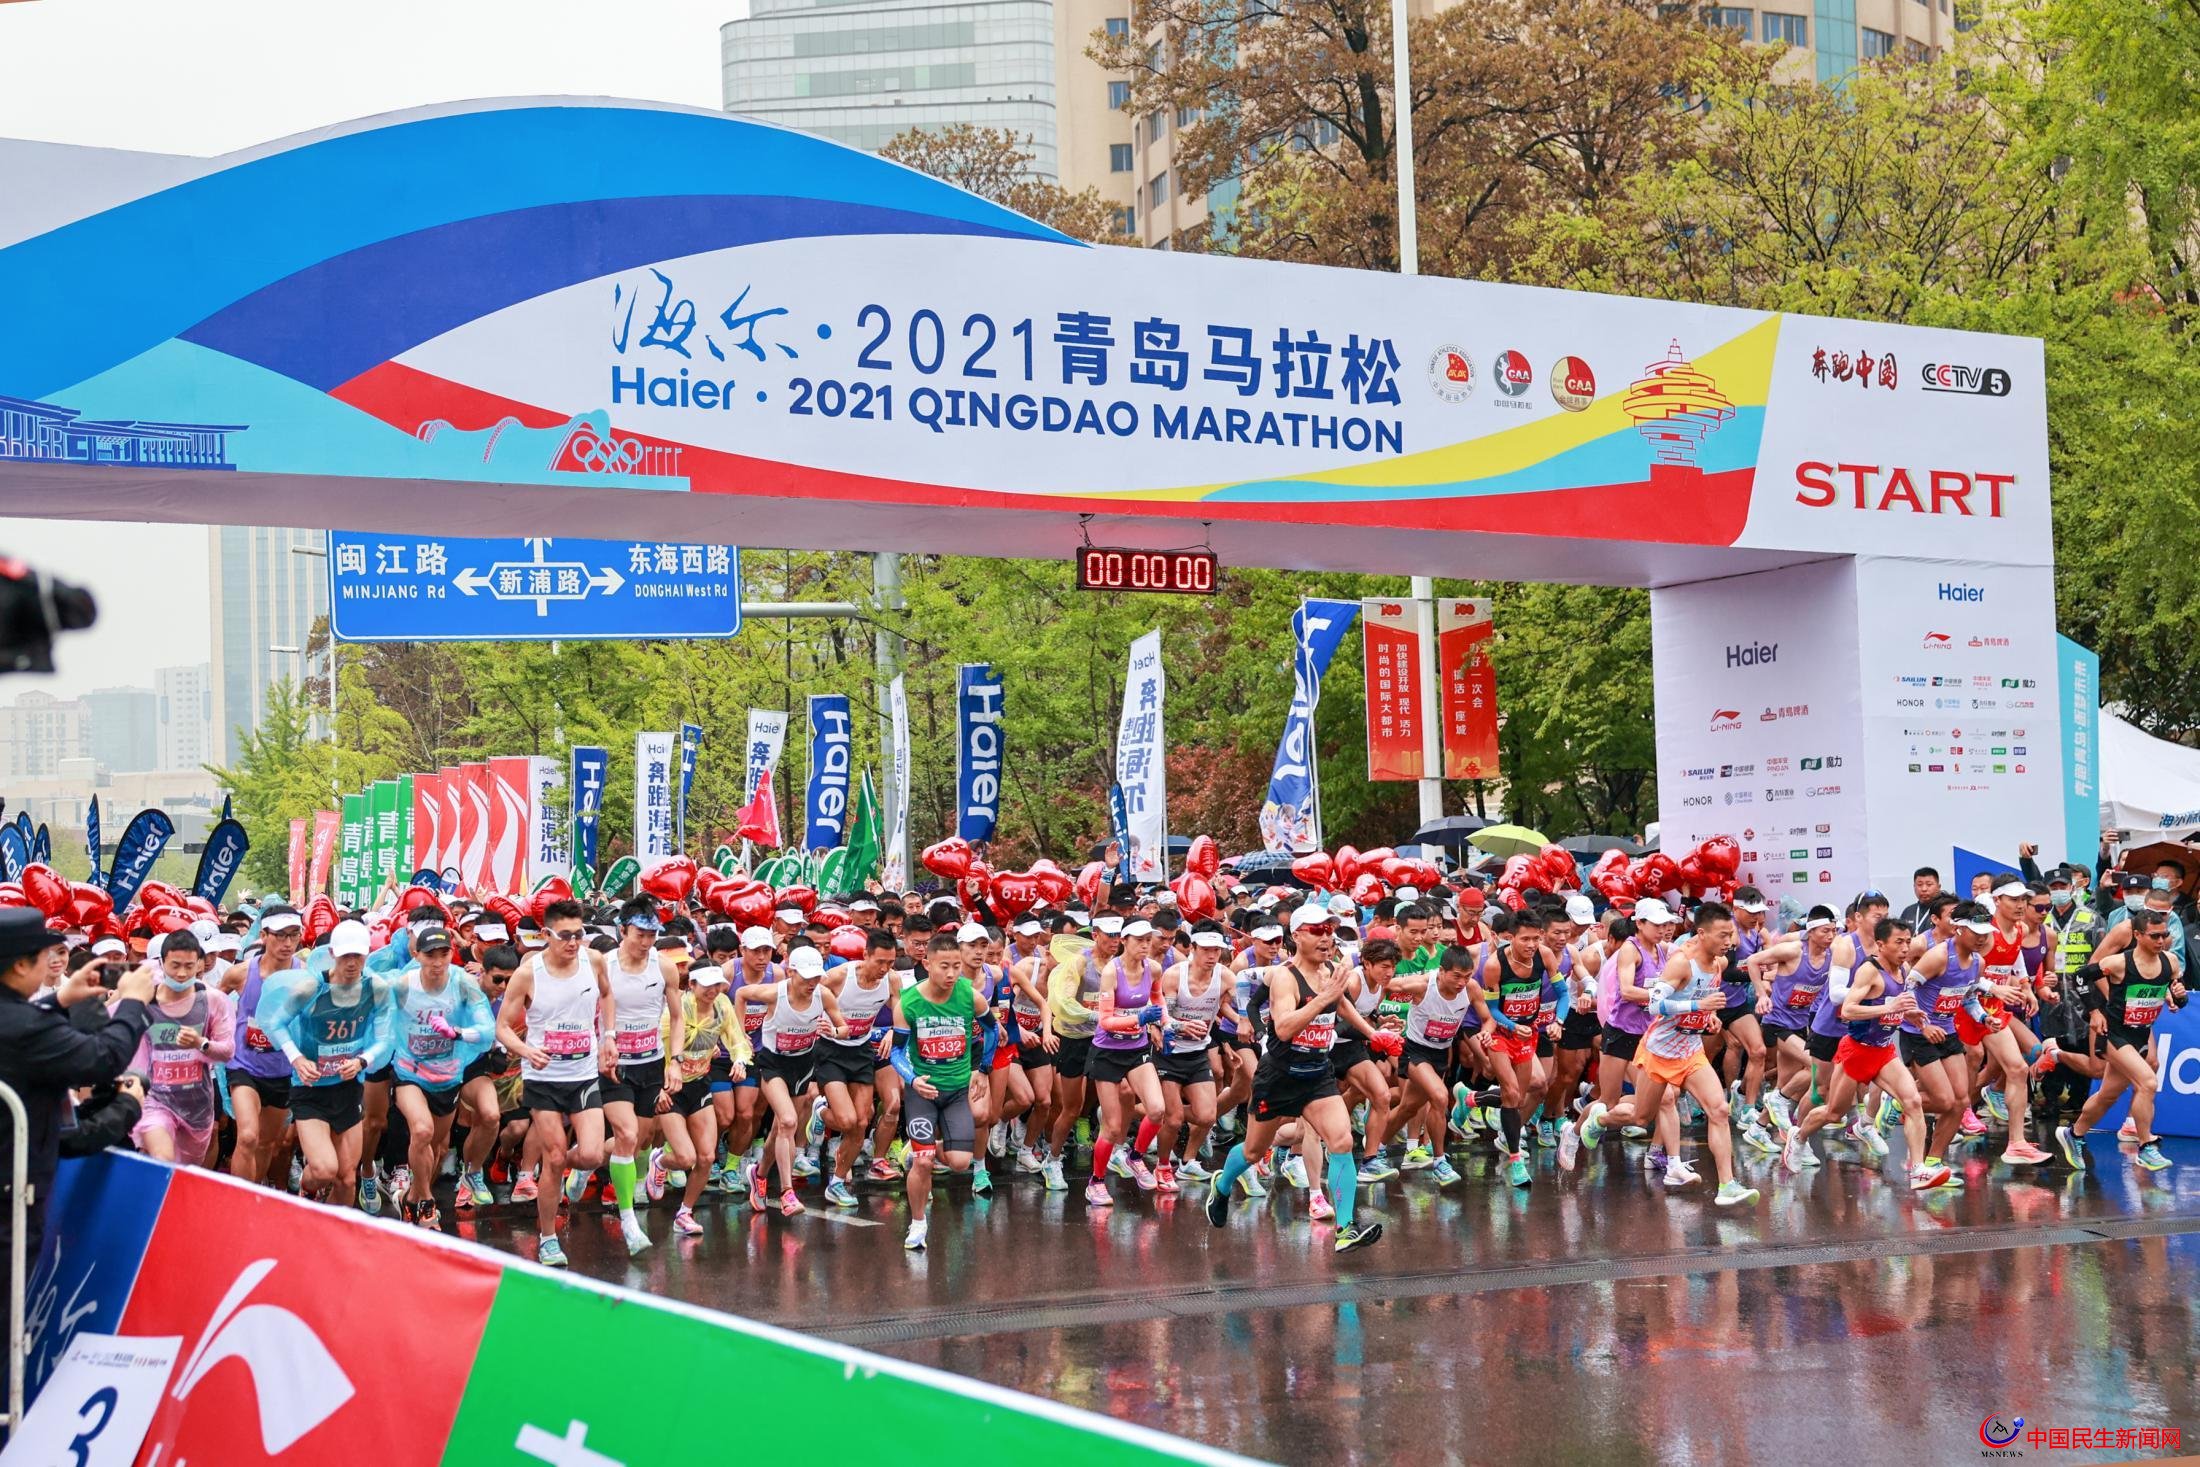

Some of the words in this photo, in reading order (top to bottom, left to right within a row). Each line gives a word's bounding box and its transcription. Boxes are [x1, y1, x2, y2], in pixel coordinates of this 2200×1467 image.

[1508, 369, 1530, 380] CAA
[1812, 346, 1898, 390] 奔跑中国
[1567, 378, 1594, 393] CAA
[612, 365, 735, 410] Haier
[788, 376, 893, 421] 2021
[909, 386, 1139, 438] QINGDAO
[1152, 408, 1402, 454] MARATHON
[1795, 461, 2015, 518] START
[336, 542, 448, 577] 闽江路
[628, 543, 731, 576] 东海西路
[499, 568, 582, 596] 新浦路
[342, 584, 418, 600] MINJIANG
[427, 584, 446, 599] Rd
[634, 583, 685, 598] DONGHAI
[686, 583, 712, 598] West
[714, 583, 728, 598] Rd
[1938, 583, 1984, 602] Haier
[1726, 641, 1778, 668] Haier
[1378, 643, 1393, 737] 时尚的国际大都市
[1896, 699, 1925, 708] HONOR
[1399, 719, 1411, 737] 活力
[1710, 722, 1742, 732] LI-NING
[968, 684, 1002, 823] Haier
[816, 709, 850, 834] Haier
[1687, 768, 1715, 777] SAILUN
[1683, 796, 1713, 807] HONOR
[117, 822, 164, 891] Haier
[1002, 886, 1039, 902] 6:15
[557, 1022, 583, 1031] Haier
[625, 1023, 649, 1032] Haier
[929, 1029, 953, 1037] Haier
[566, 1037, 590, 1050] 3:00
[635, 1035, 656, 1049] 3:00
[921, 1040, 961, 1055] A1332
[163, 1051, 192, 1061] Haier
[156, 1065, 199, 1079] A5112
